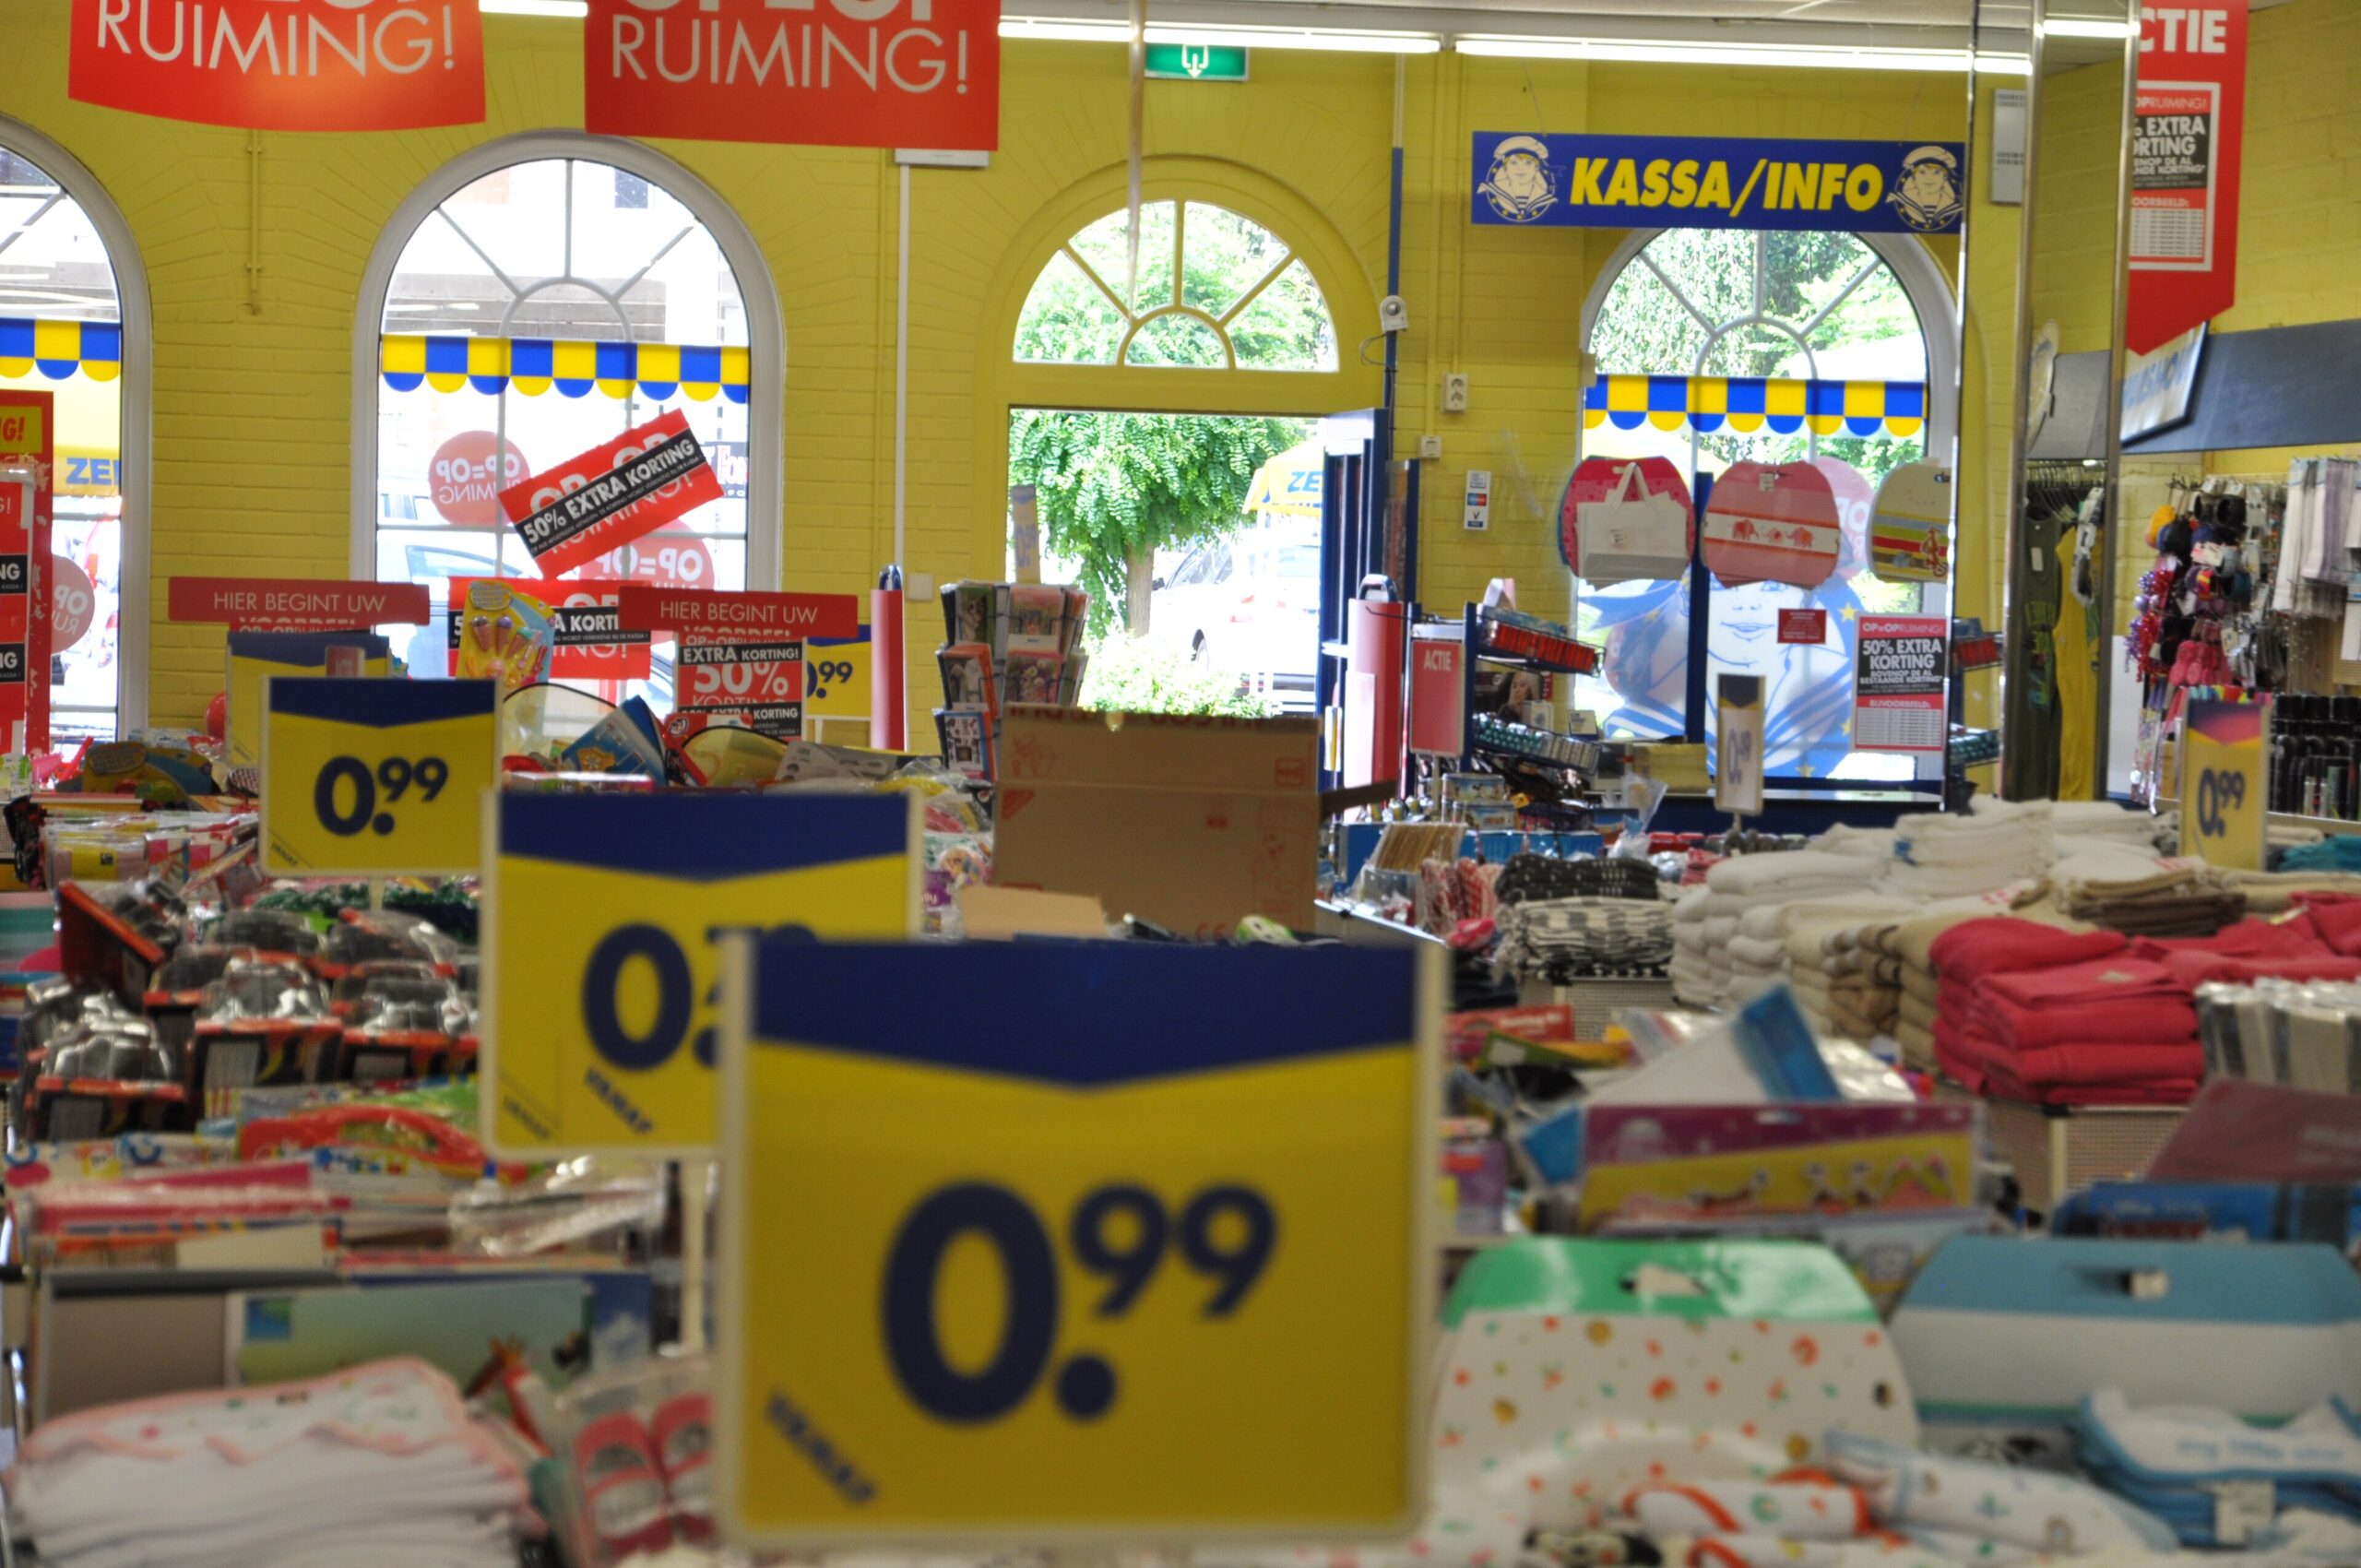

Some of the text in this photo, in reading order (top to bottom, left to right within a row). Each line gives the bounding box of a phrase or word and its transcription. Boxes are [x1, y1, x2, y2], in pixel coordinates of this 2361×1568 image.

[97, 4, 455, 77] RUIMING!
[612, 14, 967, 94] RUIMING!
[2146, 115, 2205, 137] EXTRA
[1570, 158, 1883, 217] KASSA/INFO
[521, 505, 568, 544] 50%
[564, 472, 627, 521] EXTRA
[623, 436, 696, 487] KORTING
[214, 592, 386, 612] HIER BEGINT UW
[660, 601, 817, 624] HIER BEGINT UW
[570, 614, 619, 632] KORTI
[683, 647, 800, 663] EXTRA KORTING!
[1863, 638, 1942, 655] 50% EXTRA
[1424, 649, 1452, 671] ACTIE
[1869, 653, 1935, 670] KORTING
[694, 661, 789, 695] 50%
[753, 708, 798, 719] KORTING
[314, 755, 448, 836] 0.99
[2197, 766, 2246, 838] 0.99
[880, 1180, 1280, 1427] 0.99
